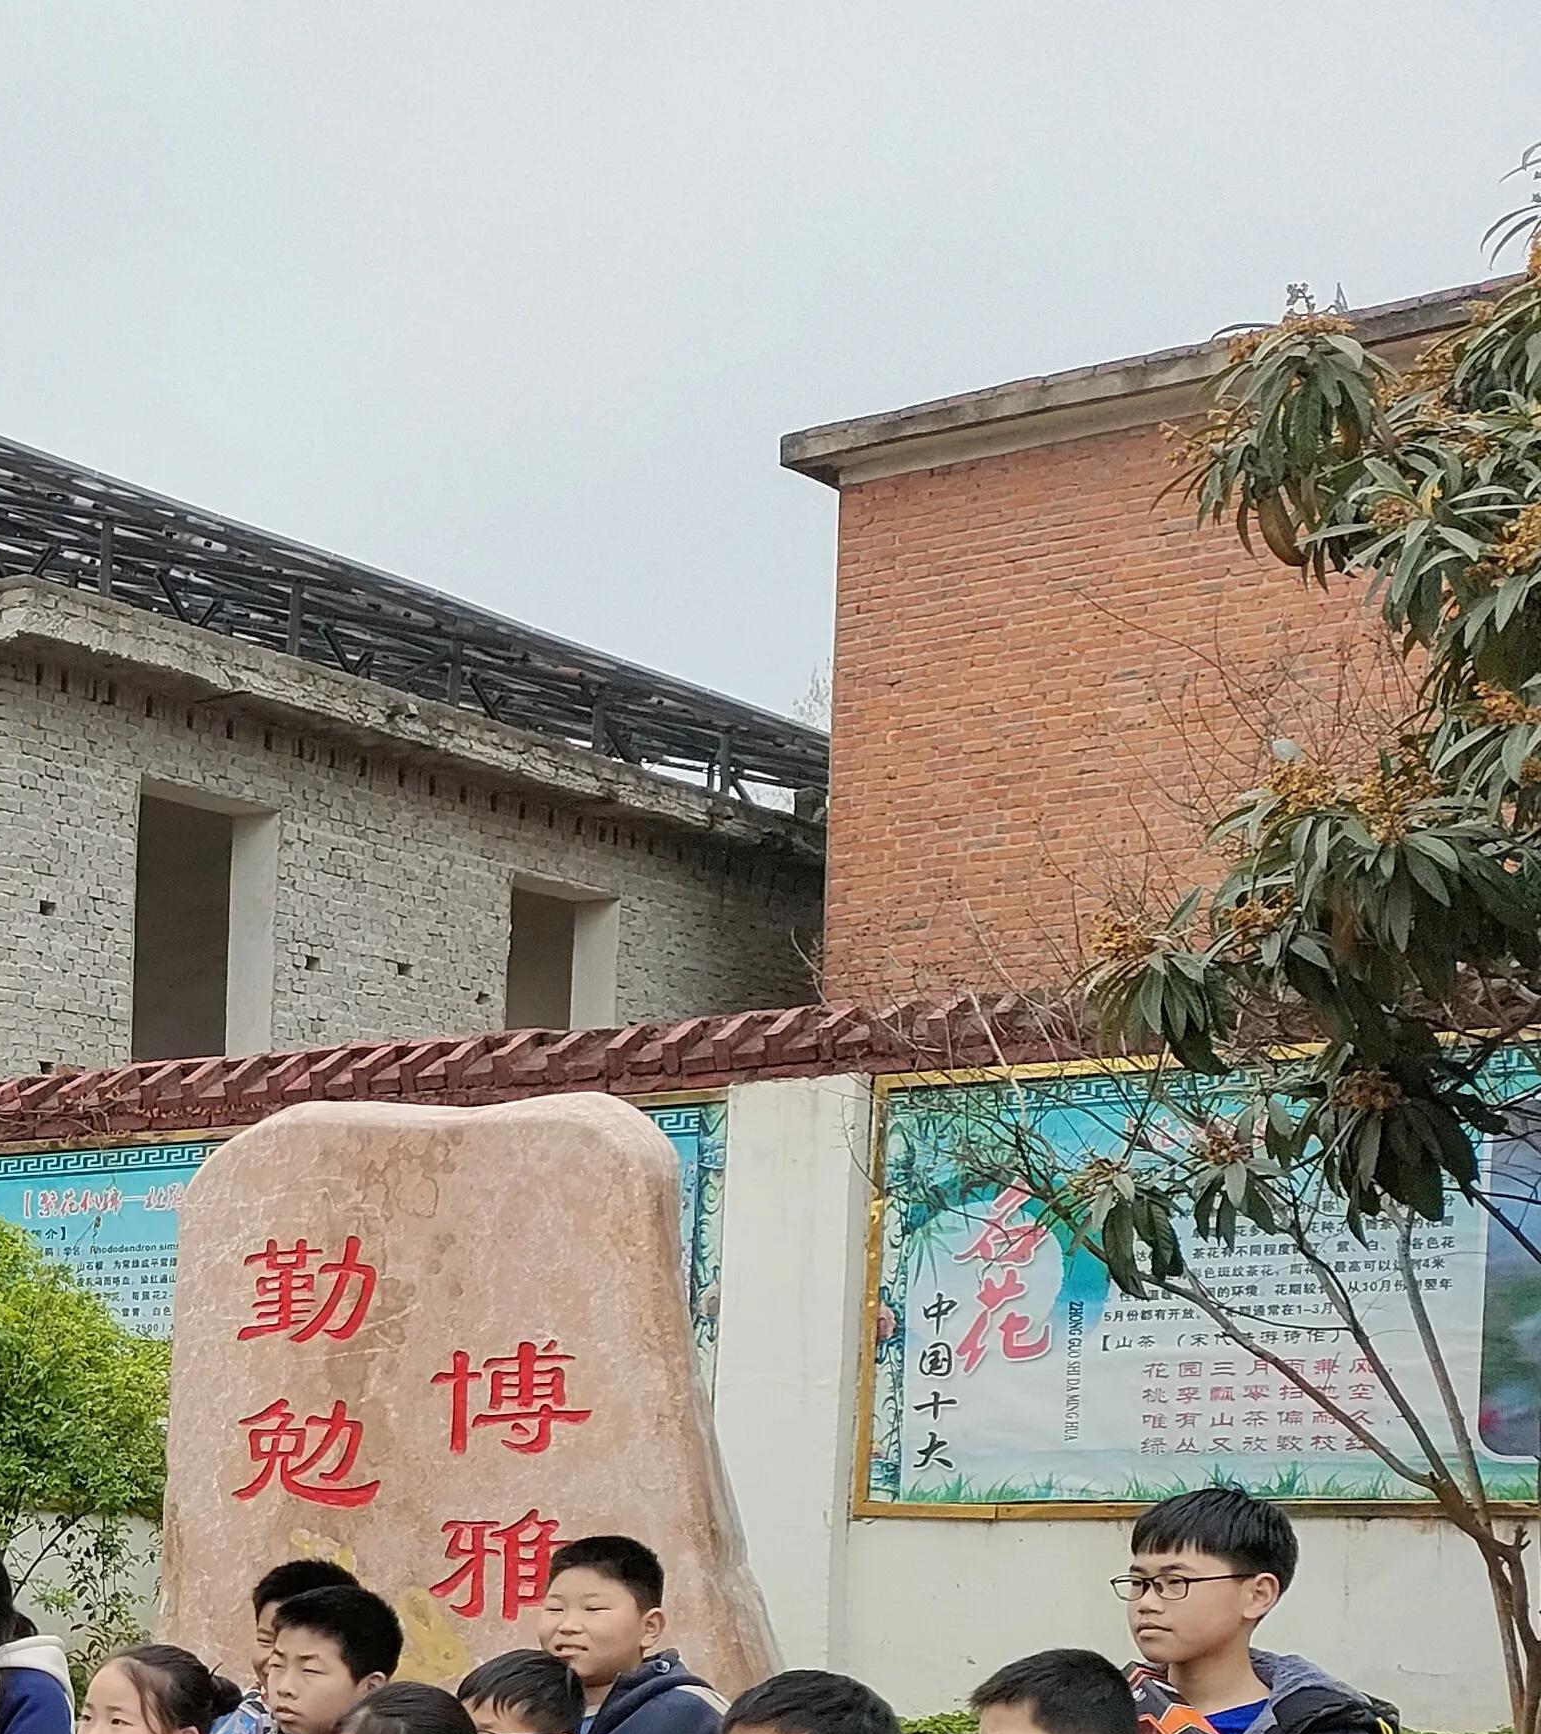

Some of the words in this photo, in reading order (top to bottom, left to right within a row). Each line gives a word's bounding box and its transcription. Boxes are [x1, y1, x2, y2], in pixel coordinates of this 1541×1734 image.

[953, 1177, 1051, 1375] 名花
[1068, 1300, 1084, 1336] ZHONG
[1067, 1337, 1083, 1359] GUO
[231, 1235, 381, 1509] 勤勉
[912, 1293, 958, 1469] 中国十大
[1066, 1361, 1081, 1376] SHI
[1066, 1378, 1081, 1392] DA
[1065, 1394, 1080, 1420] MING
[1064, 1421, 1079, 1441] HUA
[429, 1340, 593, 1622] 博雅
